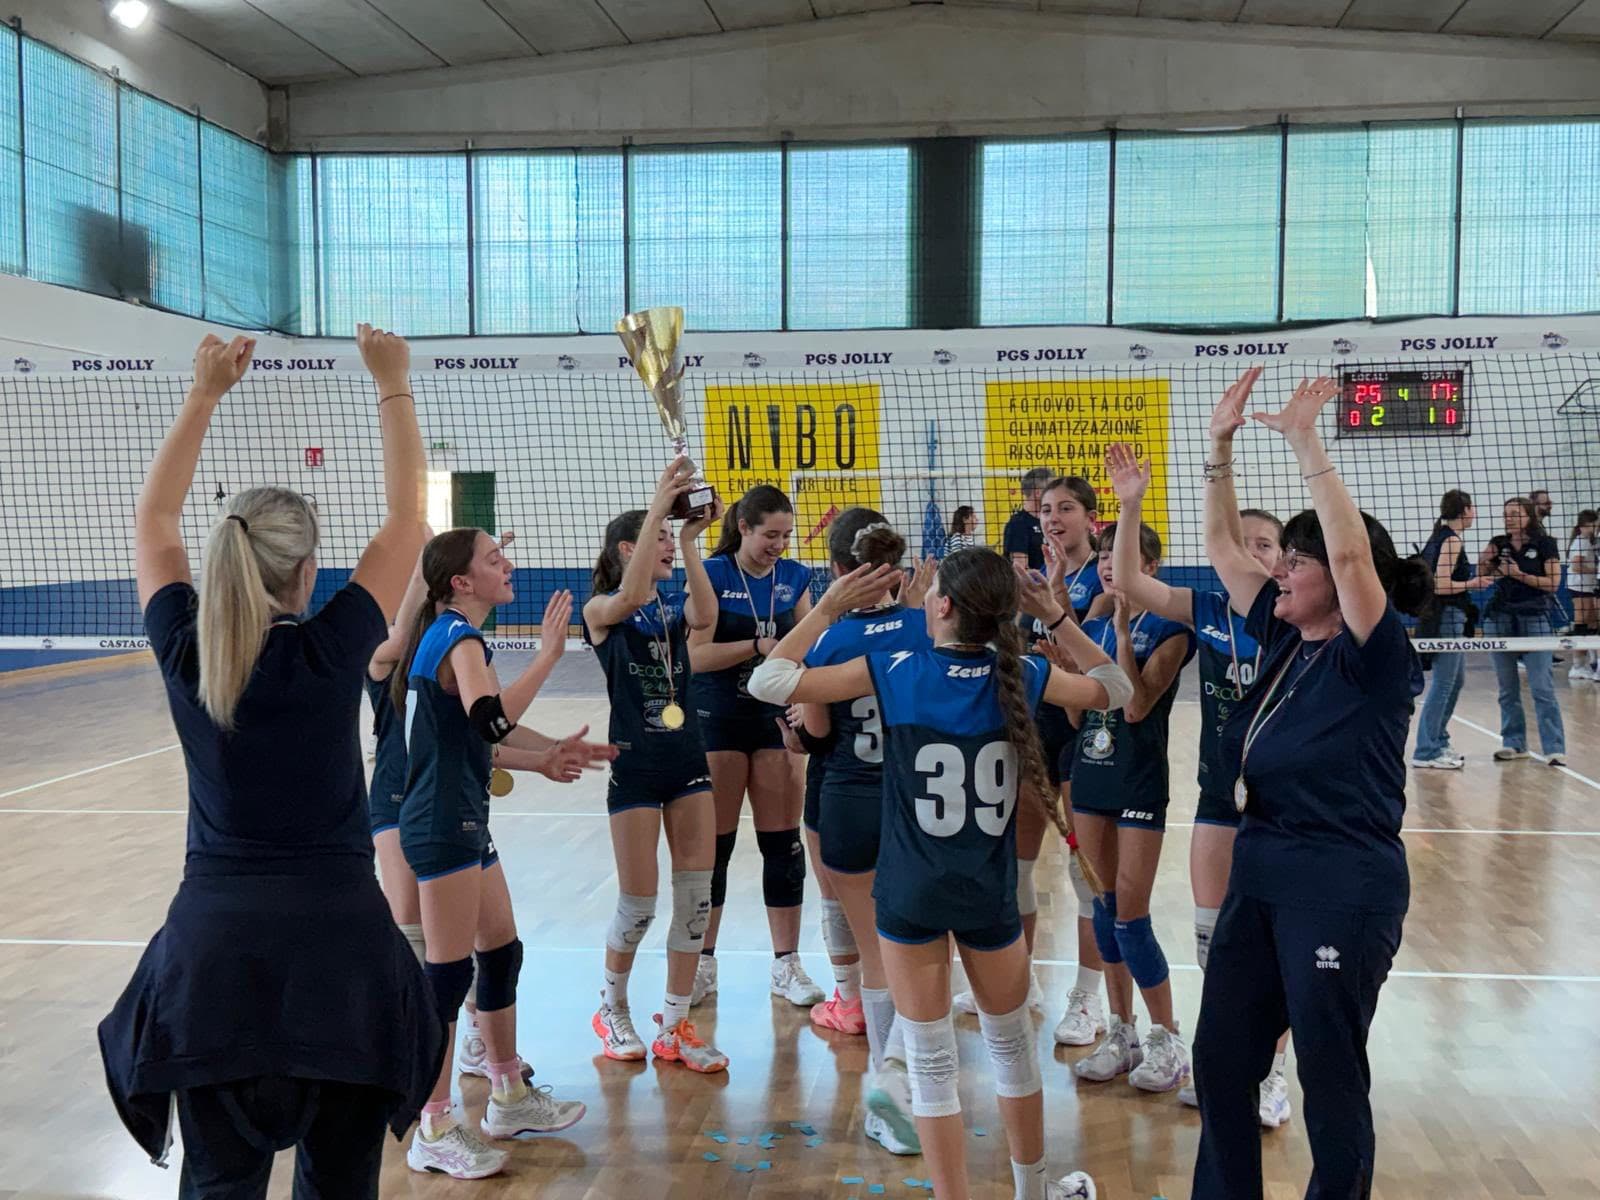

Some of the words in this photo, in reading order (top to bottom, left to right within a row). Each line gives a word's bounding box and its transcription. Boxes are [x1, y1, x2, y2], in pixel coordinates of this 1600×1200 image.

[1195, 343, 1230, 357] PGS
[1234, 341, 1289, 356] JOLLY
[1401, 339, 1436, 352] PGS
[1440, 336, 1498, 351] JOLLY
[805, 353, 837, 365] PGS
[842, 352, 893, 365] JOLLY
[996, 350, 1028, 362] PGS
[1034, 348, 1087, 361] JOLLY
[72, 360, 102, 371] PGS
[106, 359, 154, 371] JOLLY
[252, 359, 283, 371] PGS
[286, 358, 336, 371] JOLLY
[435, 358, 465, 370] PGS
[469, 357, 519, 369] JOLLY
[1355, 384, 1382, 404] 25
[1398, 388, 1409, 401] 4
[1432, 383, 1451, 400] 17
[1009, 396, 1144, 413] FOTOVOLTAICO
[1350, 410, 1360, 426] 0
[1371, 406, 1385, 426] 2
[1429, 407, 1436, 424] 1
[1445, 408, 1456, 424] 0
[728, 404, 856, 469] NIBO
[1009, 420, 1143, 437] CLIMATIZZAZIONE
[1009, 443, 1143, 460] RISCALDAMEO
[721, 590, 749, 599] Zeus
[864, 620, 903, 635] Zeus
[1200, 624, 1232, 642] Zeus
[99, 640, 153, 648] CASTAGN
[484, 641, 536, 650] TAGNOLE
[1418, 641, 1507, 650] CASTAGNOLE
[946, 665, 991, 678] Zeus
[1225, 662, 1253, 685] 40
[914, 741, 1018, 838] 39
